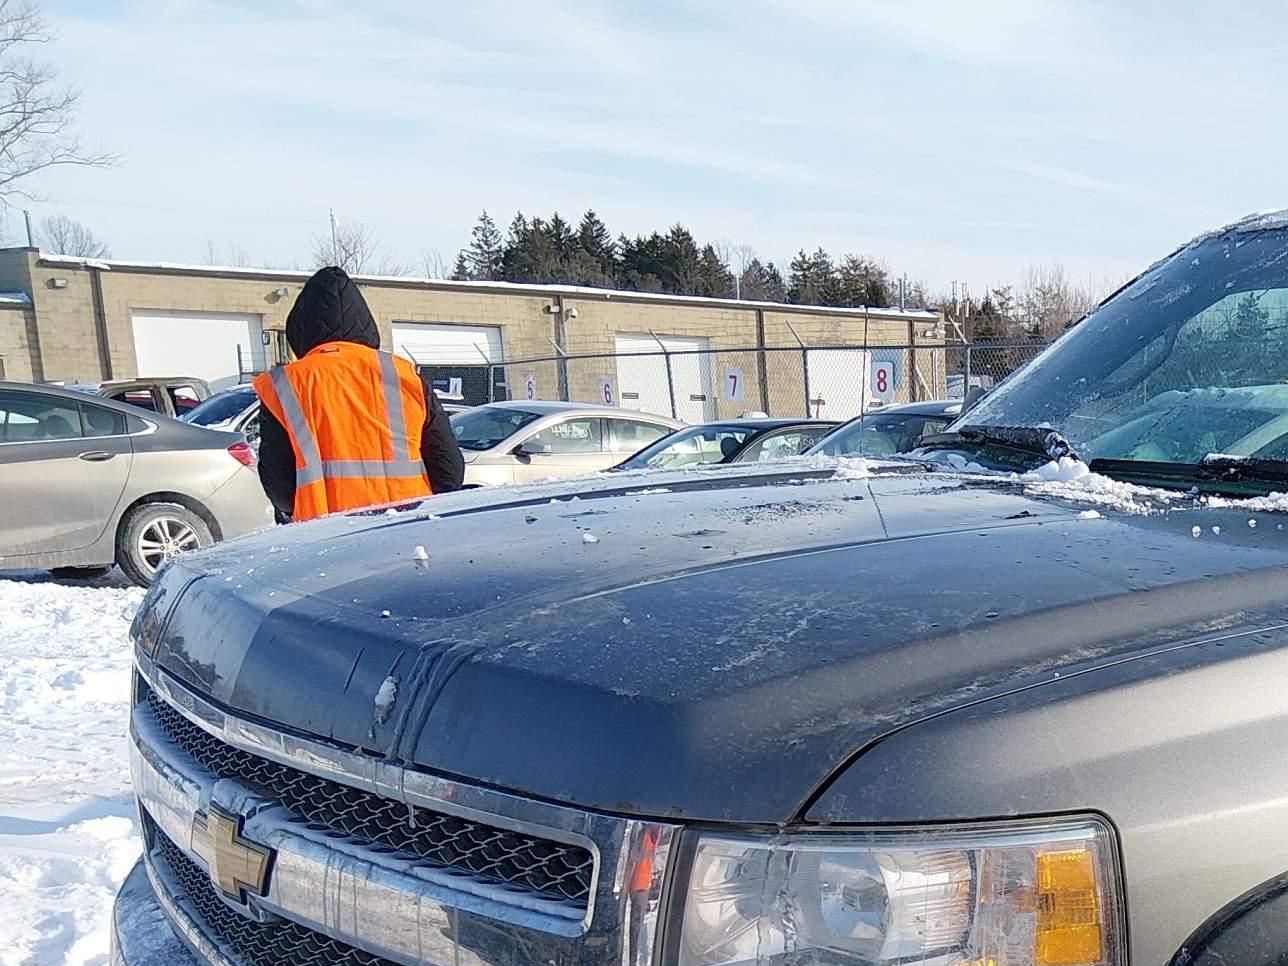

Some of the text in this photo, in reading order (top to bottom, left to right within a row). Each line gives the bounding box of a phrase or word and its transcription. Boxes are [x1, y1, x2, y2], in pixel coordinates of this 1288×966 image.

[526, 380, 535, 400] 5
[729, 375, 738, 397] 7
[877, 369, 888, 393] 8
[604, 383, 613, 403] 6
